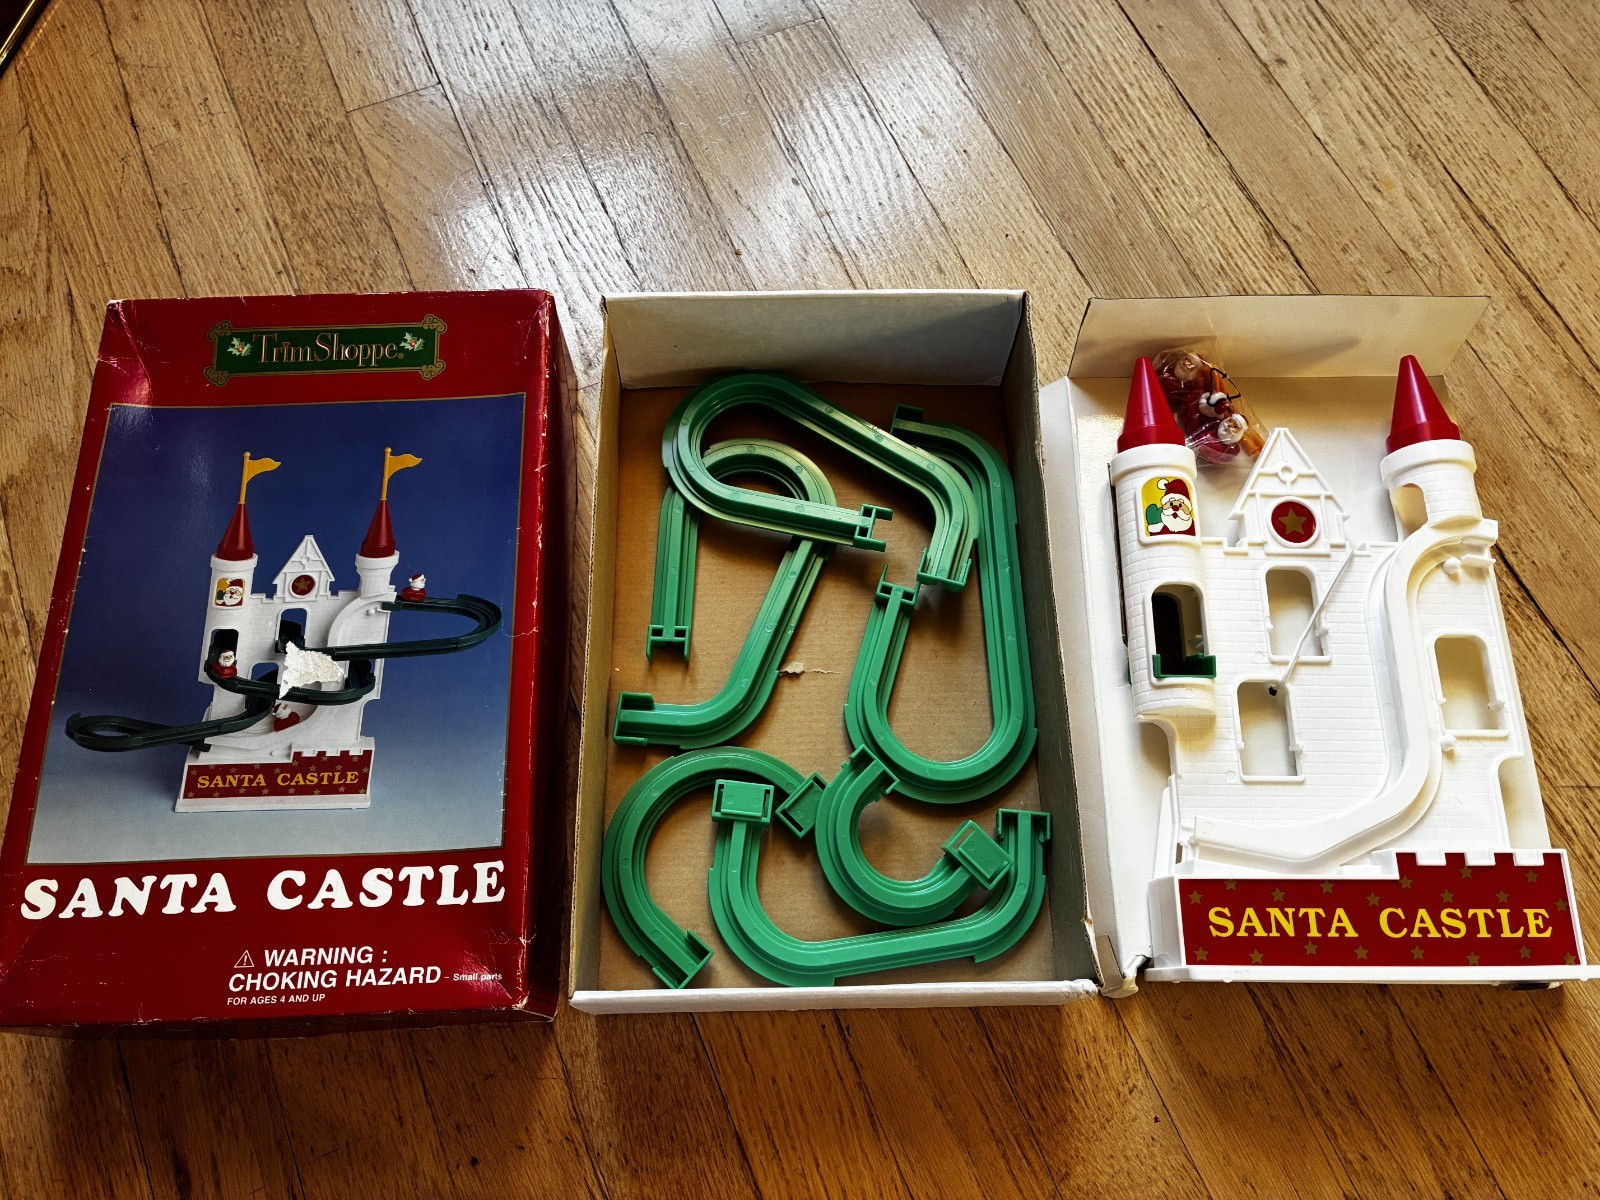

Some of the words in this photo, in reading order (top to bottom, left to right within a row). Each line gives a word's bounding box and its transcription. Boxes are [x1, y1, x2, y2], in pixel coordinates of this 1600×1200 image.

[197, 773, 267, 789] SANTA
[276, 771, 359, 786] CASTLE
[20, 872, 237, 920] SANTA
[266, 860, 505, 910] CASTLE
[1208, 907, 1359, 938] SANTA
[1379, 907, 1552, 938] CASTLE
[264, 946, 374, 967] WARNING
[228, 969, 338, 992] CHOKING
[345, 966, 441, 987] HAZARD
[453, 973, 478, 981] Small
[480, 972, 503, 982] parts
[226, 997, 248, 1006] FOR
[250, 995, 278, 1005] AGES
[279, 995, 286, 1004] 4
[288, 994, 310, 1003] AND
[312, 993, 326, 1002] UP
